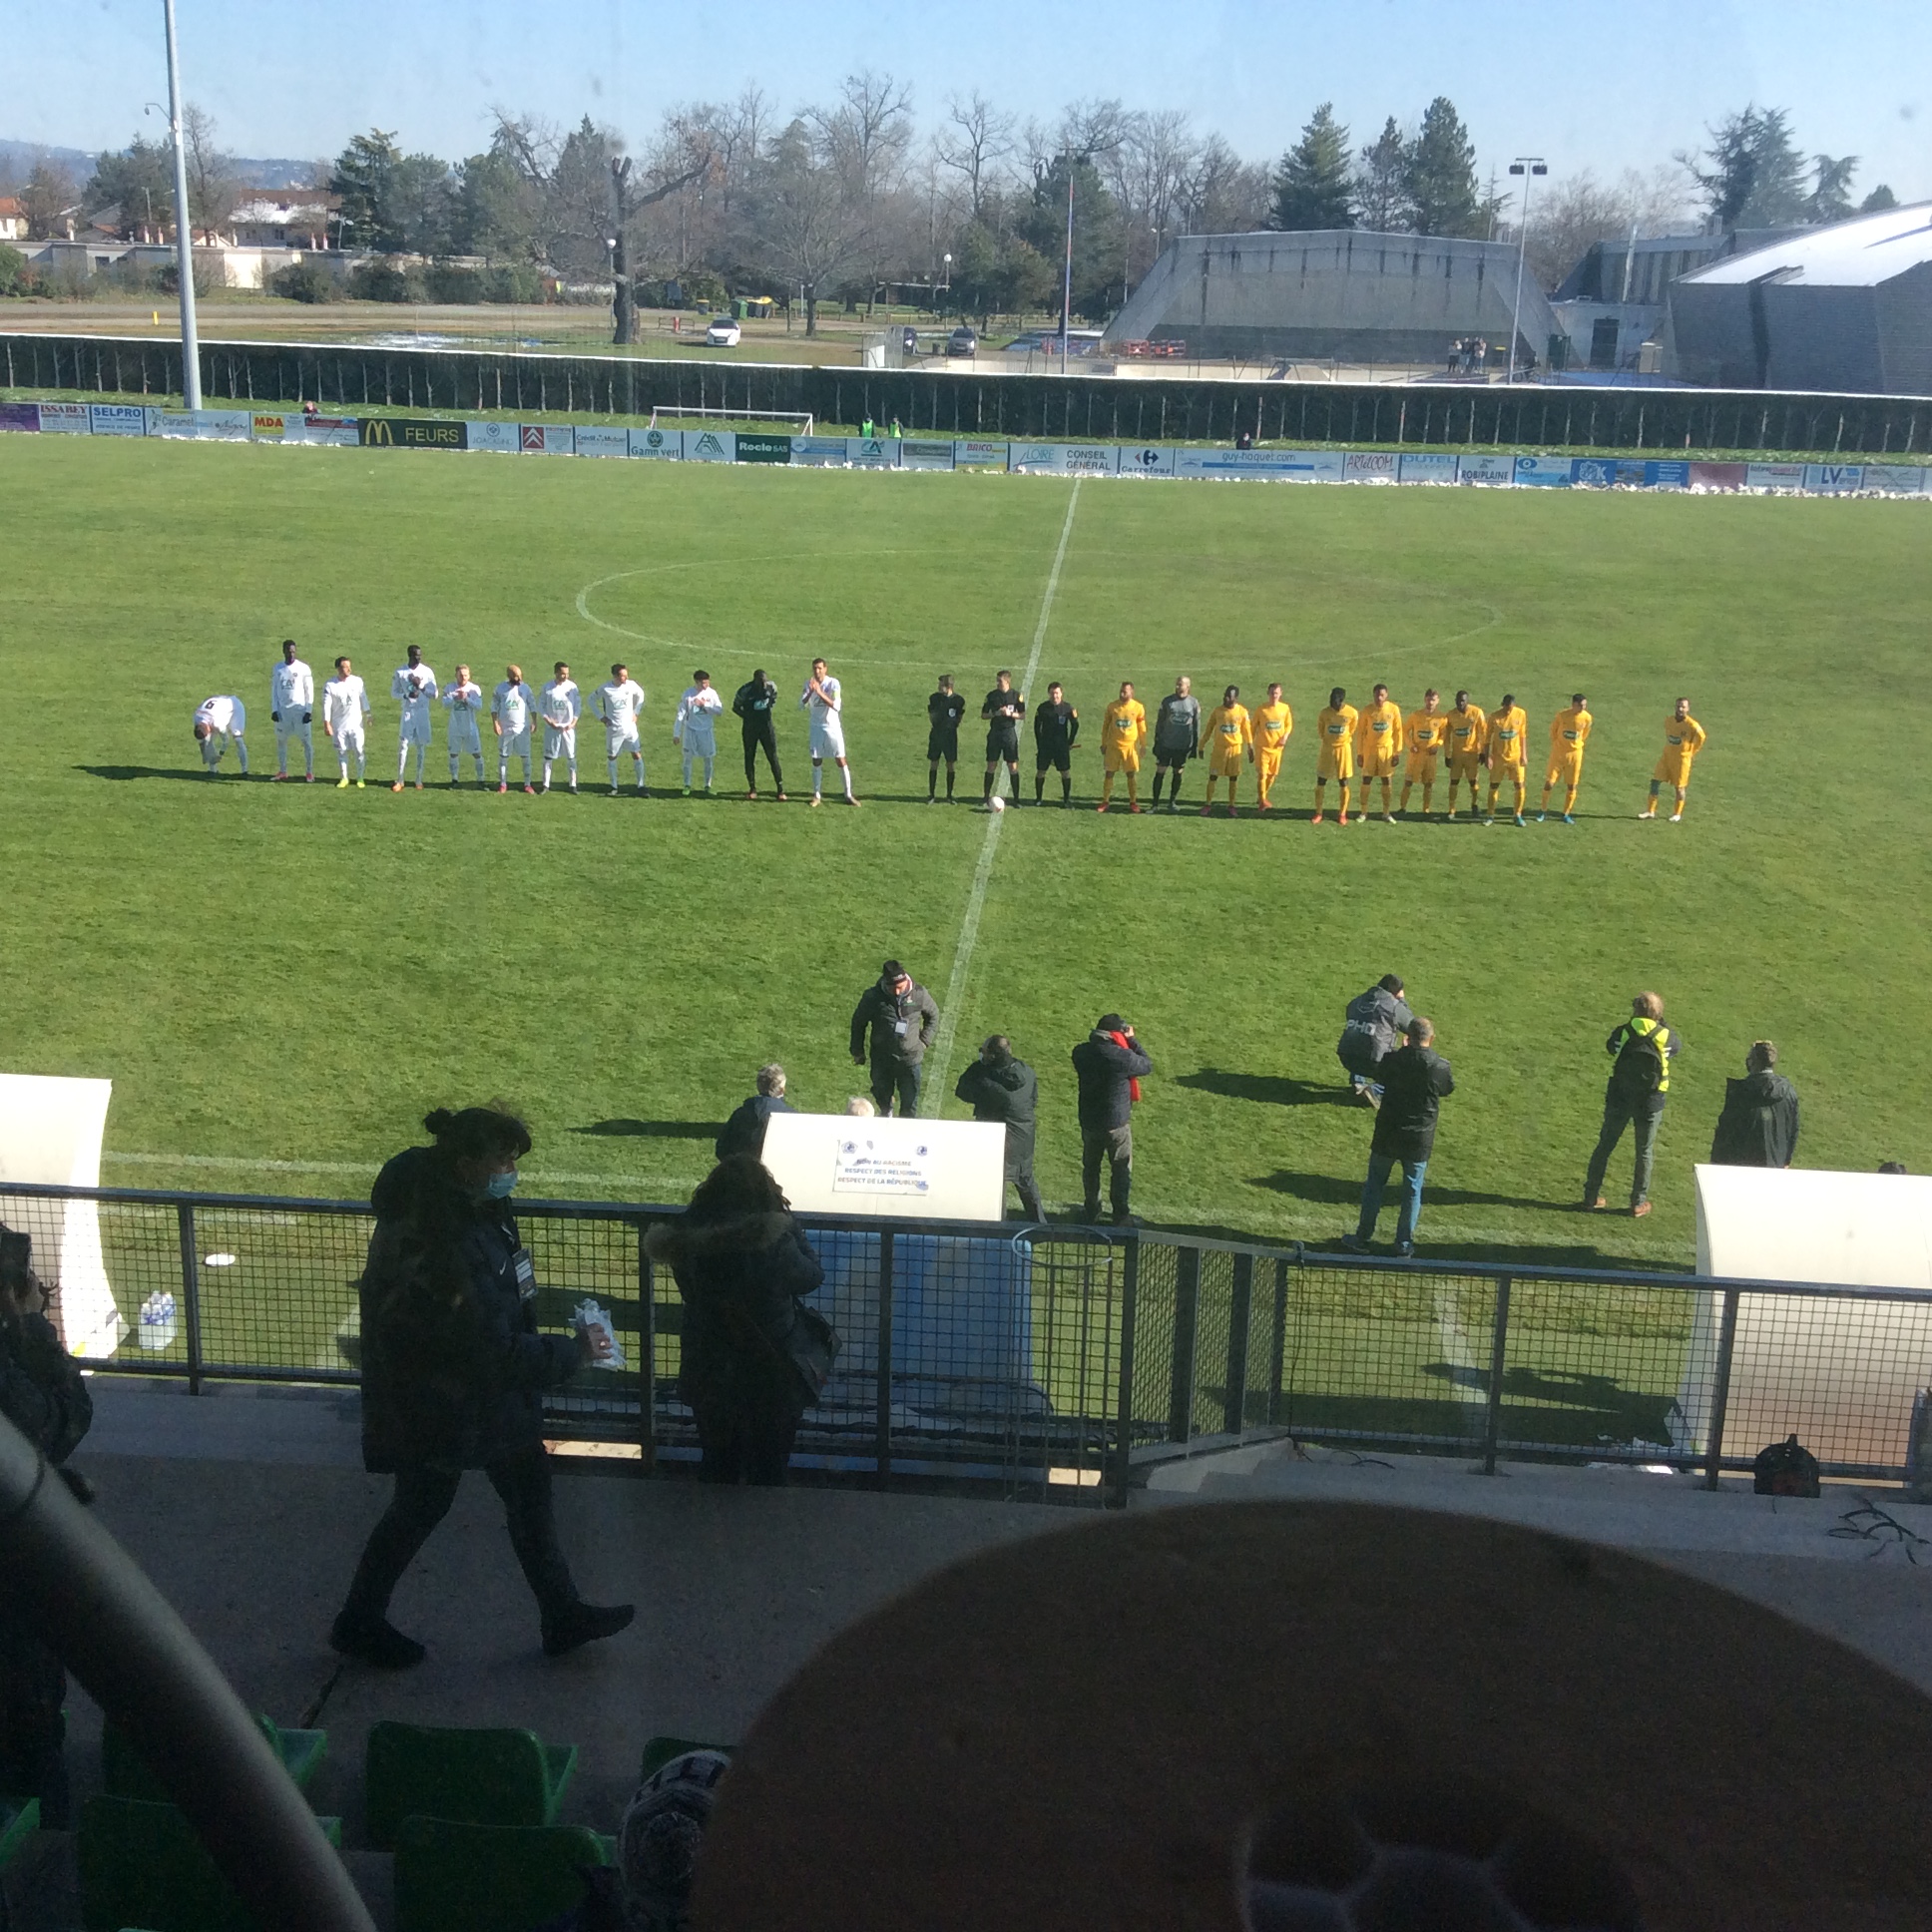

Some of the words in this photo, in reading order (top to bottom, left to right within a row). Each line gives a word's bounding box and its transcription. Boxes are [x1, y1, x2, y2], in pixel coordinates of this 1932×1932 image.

[94, 407, 141, 417] SELPRO
[254, 417, 283, 427] MDA
[405, 427, 459, 442] FEURS
[661, 448, 680, 457] vert
[1026, 449, 1055, 459] LOIRE
[1067, 450, 1107, 459] CONSEIL
[1066, 459, 1111, 470] GÉNÉRAL
